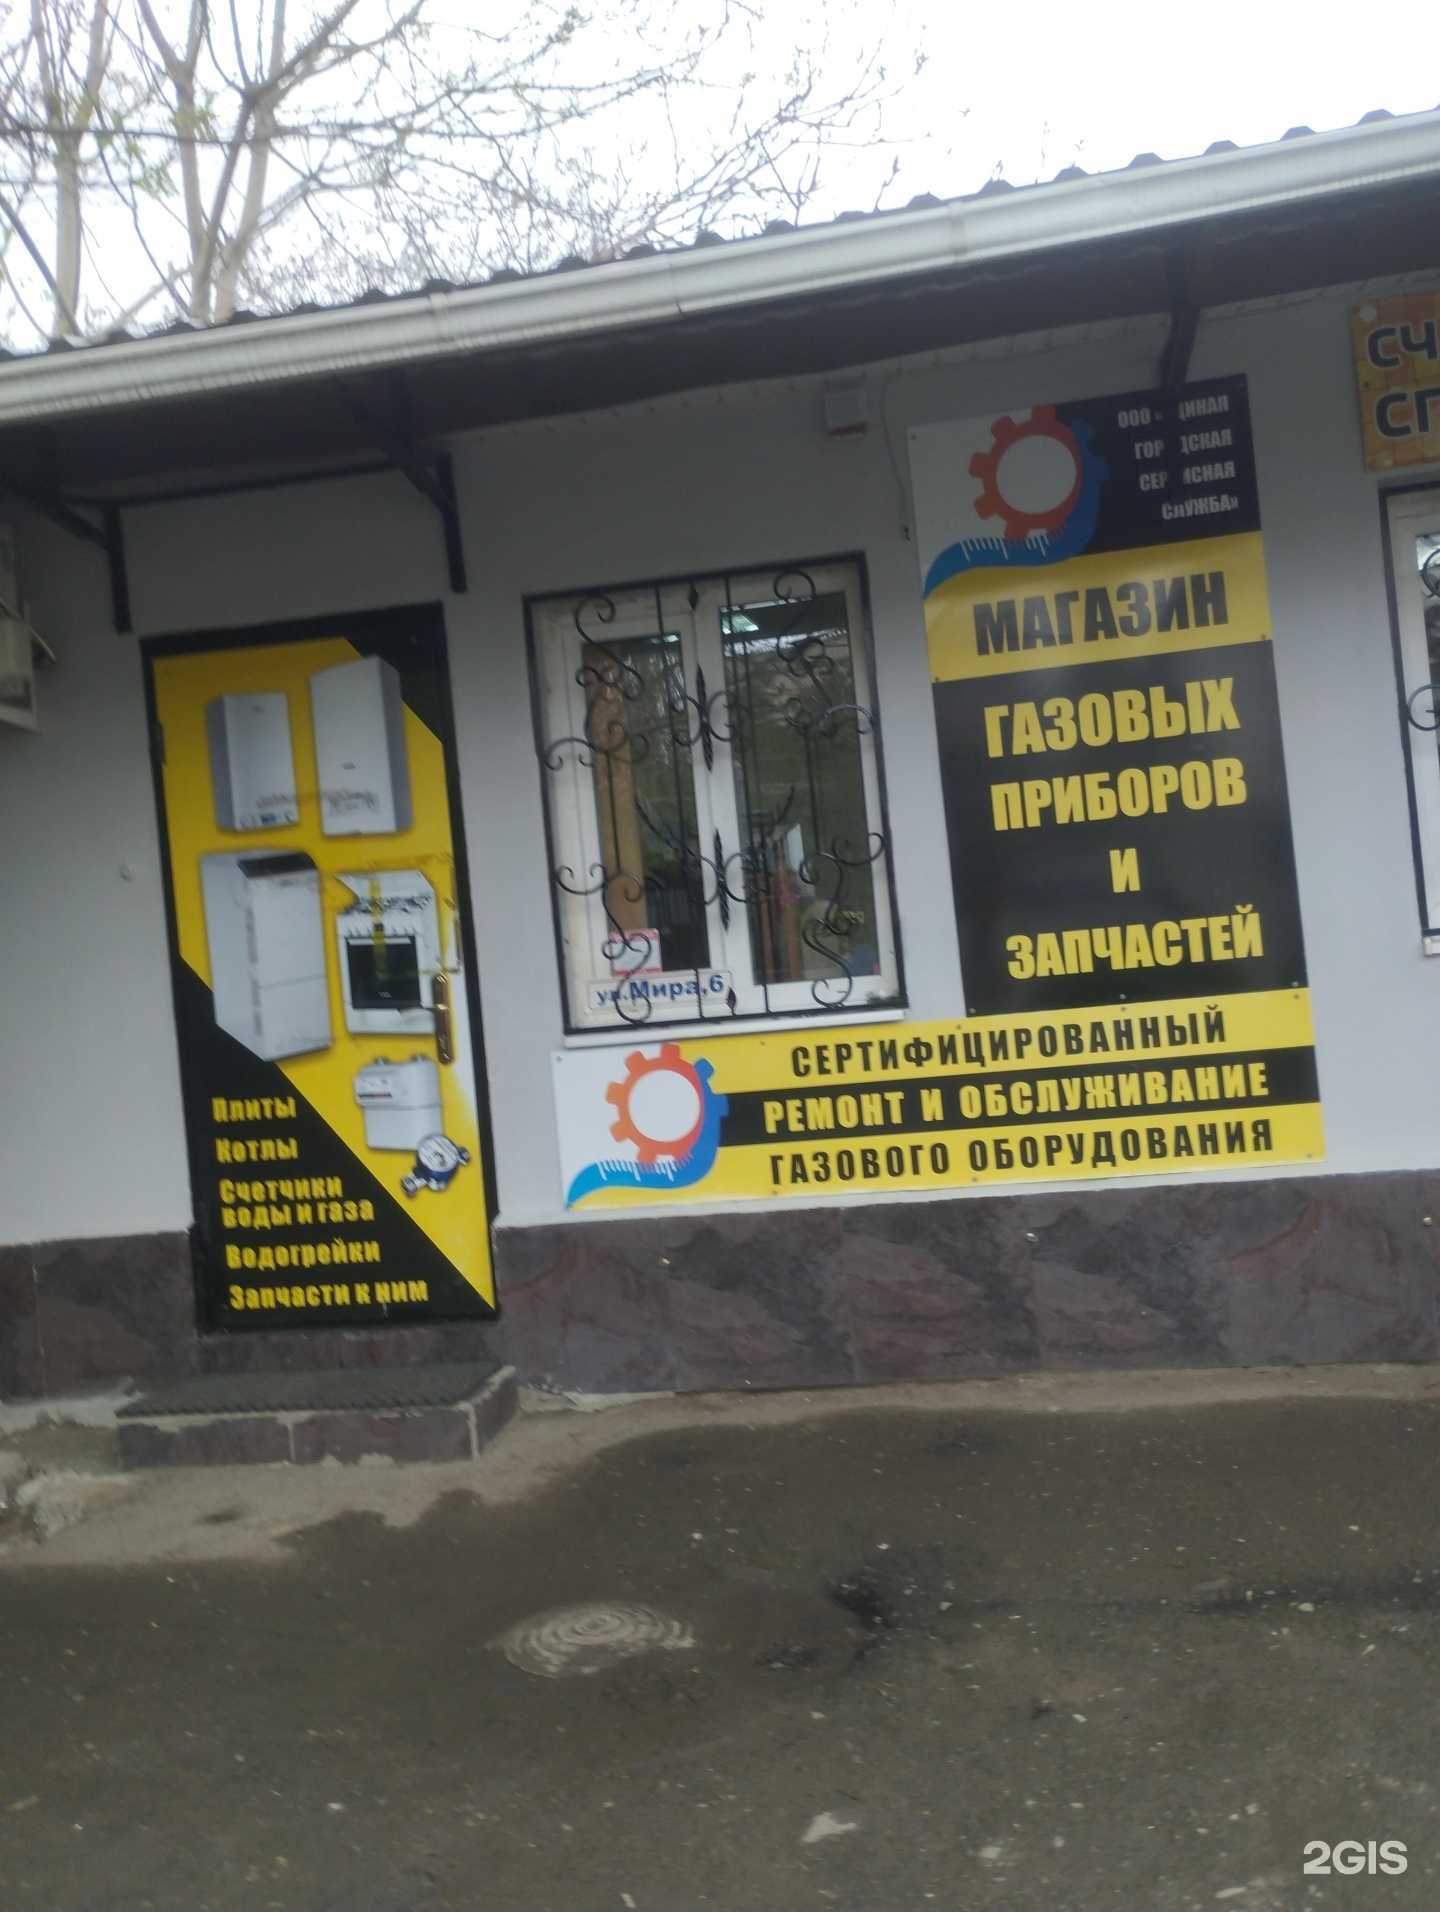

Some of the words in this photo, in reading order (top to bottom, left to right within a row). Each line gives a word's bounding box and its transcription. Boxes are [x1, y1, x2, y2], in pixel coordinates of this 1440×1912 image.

[1134, 428, 1233, 460] ГОРДСКАЯ
[1139, 460, 1236, 492] СЕРИСНАЯ
[973, 571, 1228, 656] МАГАЗИН
[983, 677, 1241, 758] ГАЗОВЫХ
[990, 757, 1248, 831] ПРИБОРОВ
[1109, 847, 1141, 893] И
[1005, 903, 1264, 980] ЗАПЧАСТЕЙ
[791, 1003, 1226, 1078] СЕРТИФИЦИРОВАННЫЙ
[212, 1097, 297, 1122] Плиты
[763, 1091, 904, 1134] РЕМОНТ
[921, 1088, 945, 1121] И
[959, 1062, 1270, 1119] ОБСЛУЖИВАНИЕ
[215, 1137, 299, 1164] Котлы
[769, 1142, 950, 1185] ГАЗОВОГО
[969, 1118, 1274, 1171] ОБОРУДОВАНИЯ
[219, 1176, 343, 1204] Счетчики
[225, 1237, 381, 1270] Водогрейки
[229, 1283, 351, 1310] Запчасти
[374, 1280, 429, 1304] ним
